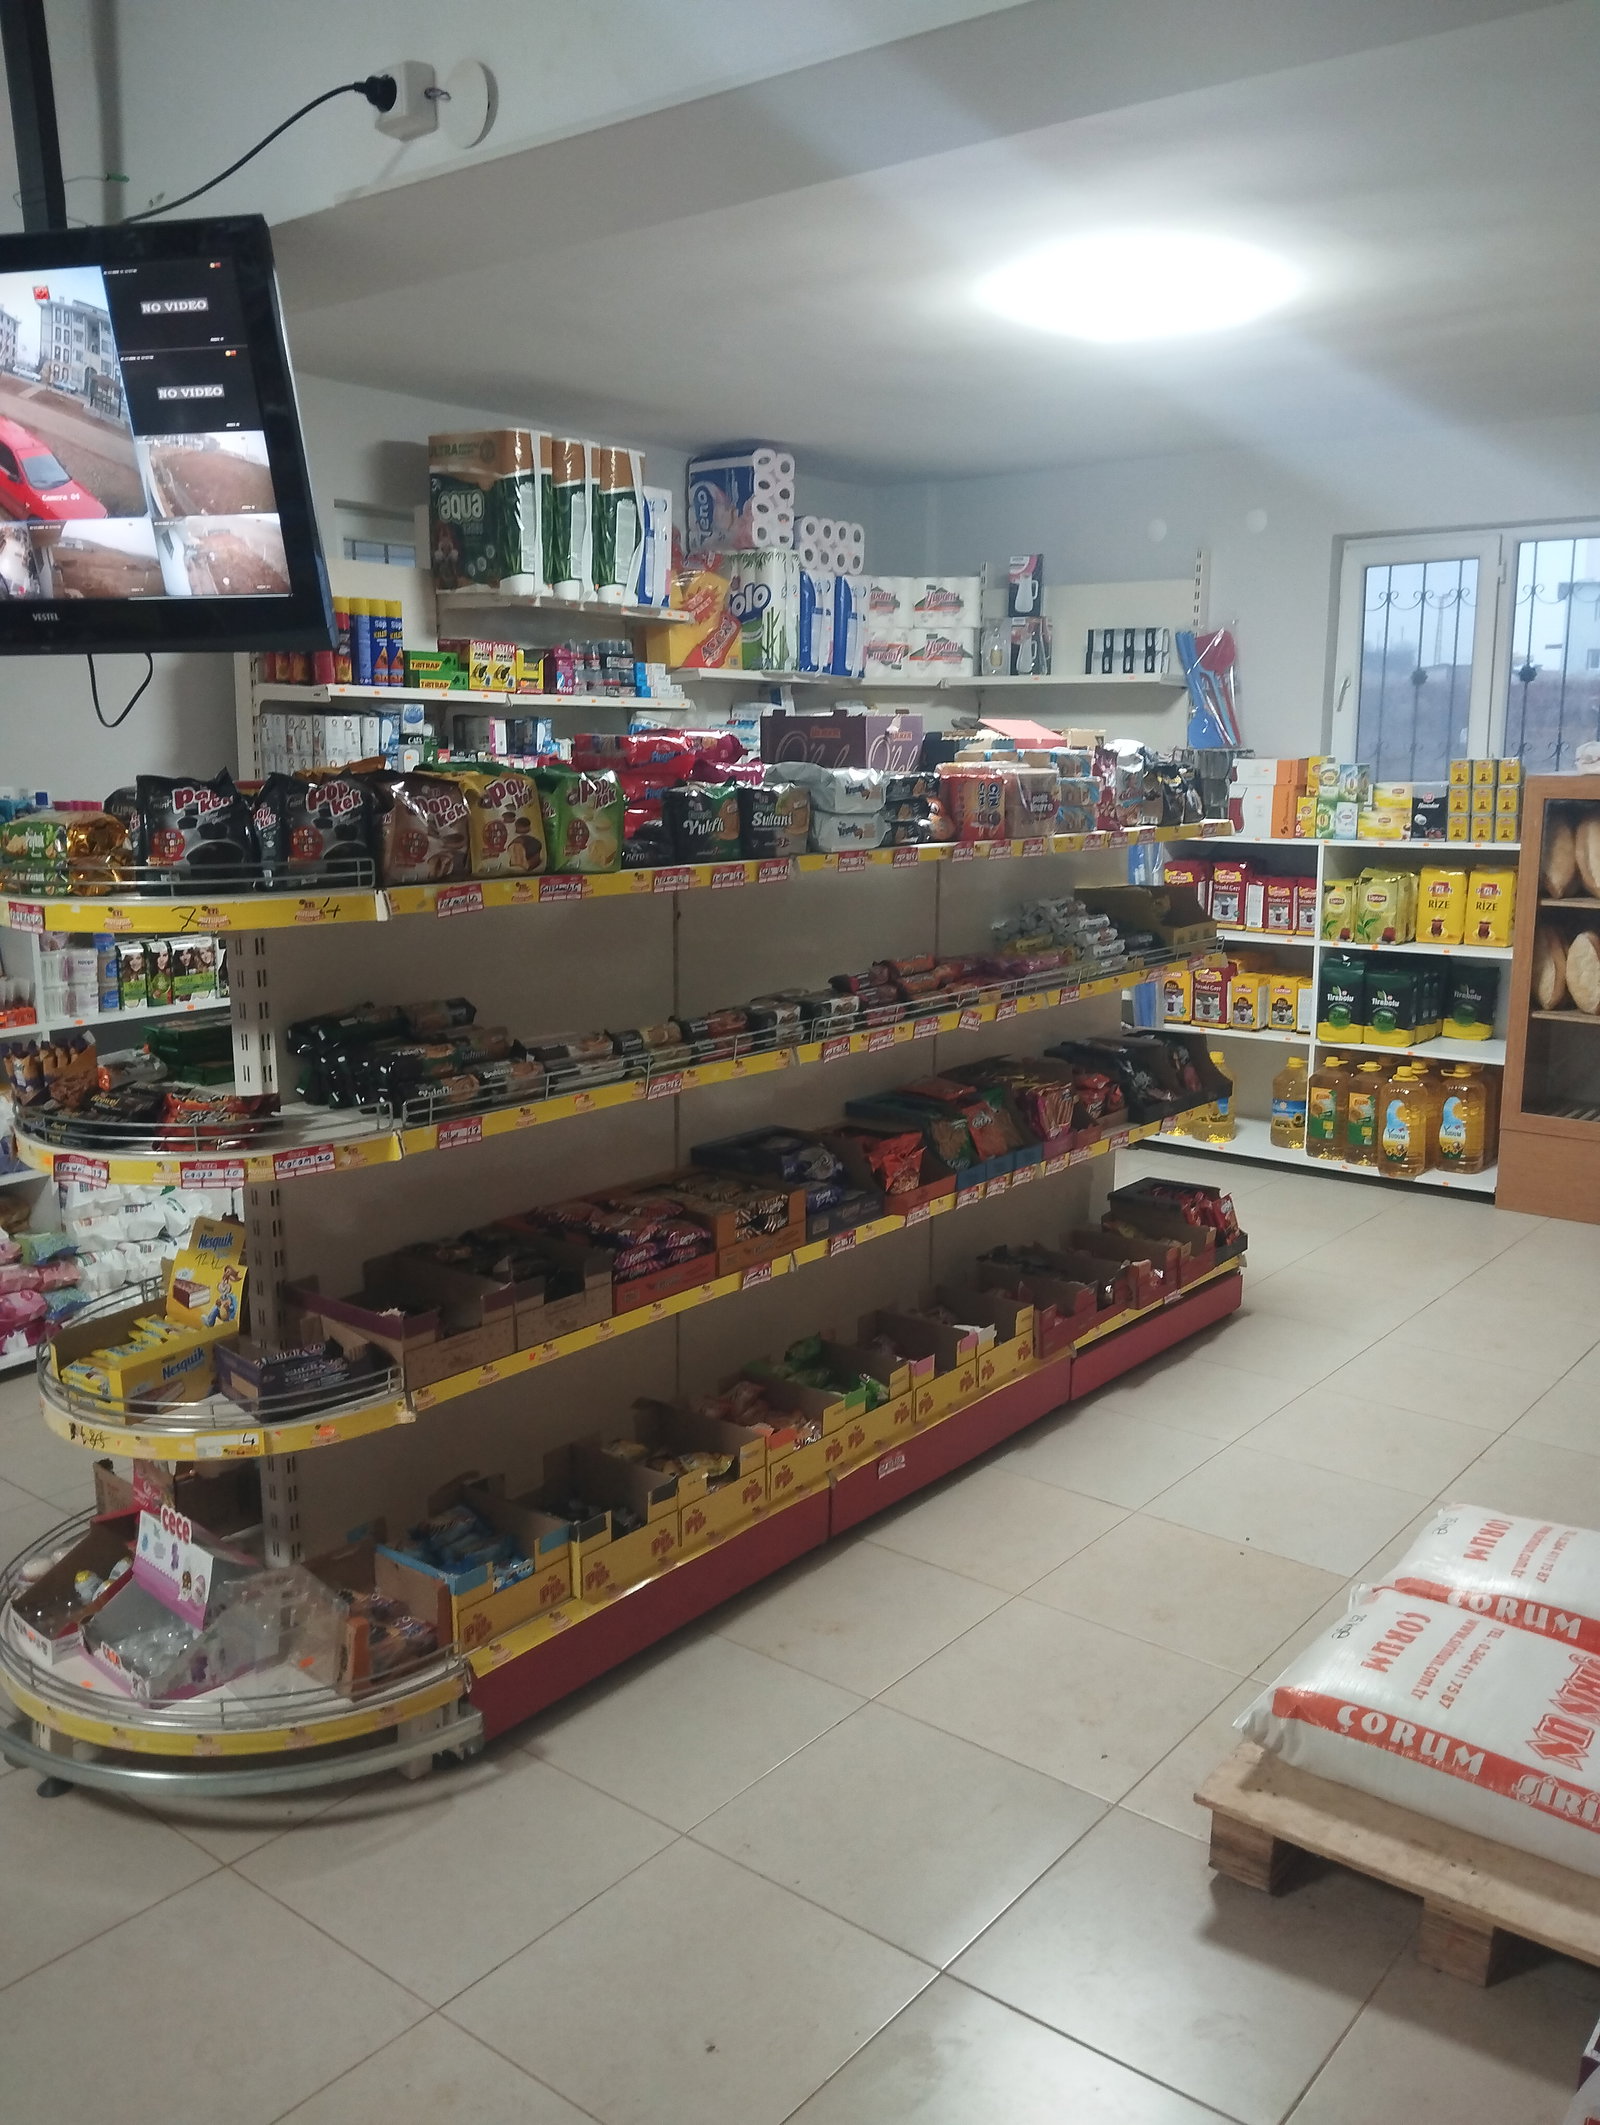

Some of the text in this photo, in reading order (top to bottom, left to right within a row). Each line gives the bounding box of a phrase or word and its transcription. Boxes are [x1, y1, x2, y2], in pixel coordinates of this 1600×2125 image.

[142, 300, 206, 313] NO VIDEO
[159, 386, 222, 399] NO VIDEO
[440, 492, 483, 521] aqua
[32, 613, 59, 621] VESTEL
[1368, 894, 1387, 902] Lipton
[199, 1231, 234, 1249] Nesquik
[162, 1346, 205, 1380] Nesquik
[1337, 1705, 1486, 1776] ÇORUM
